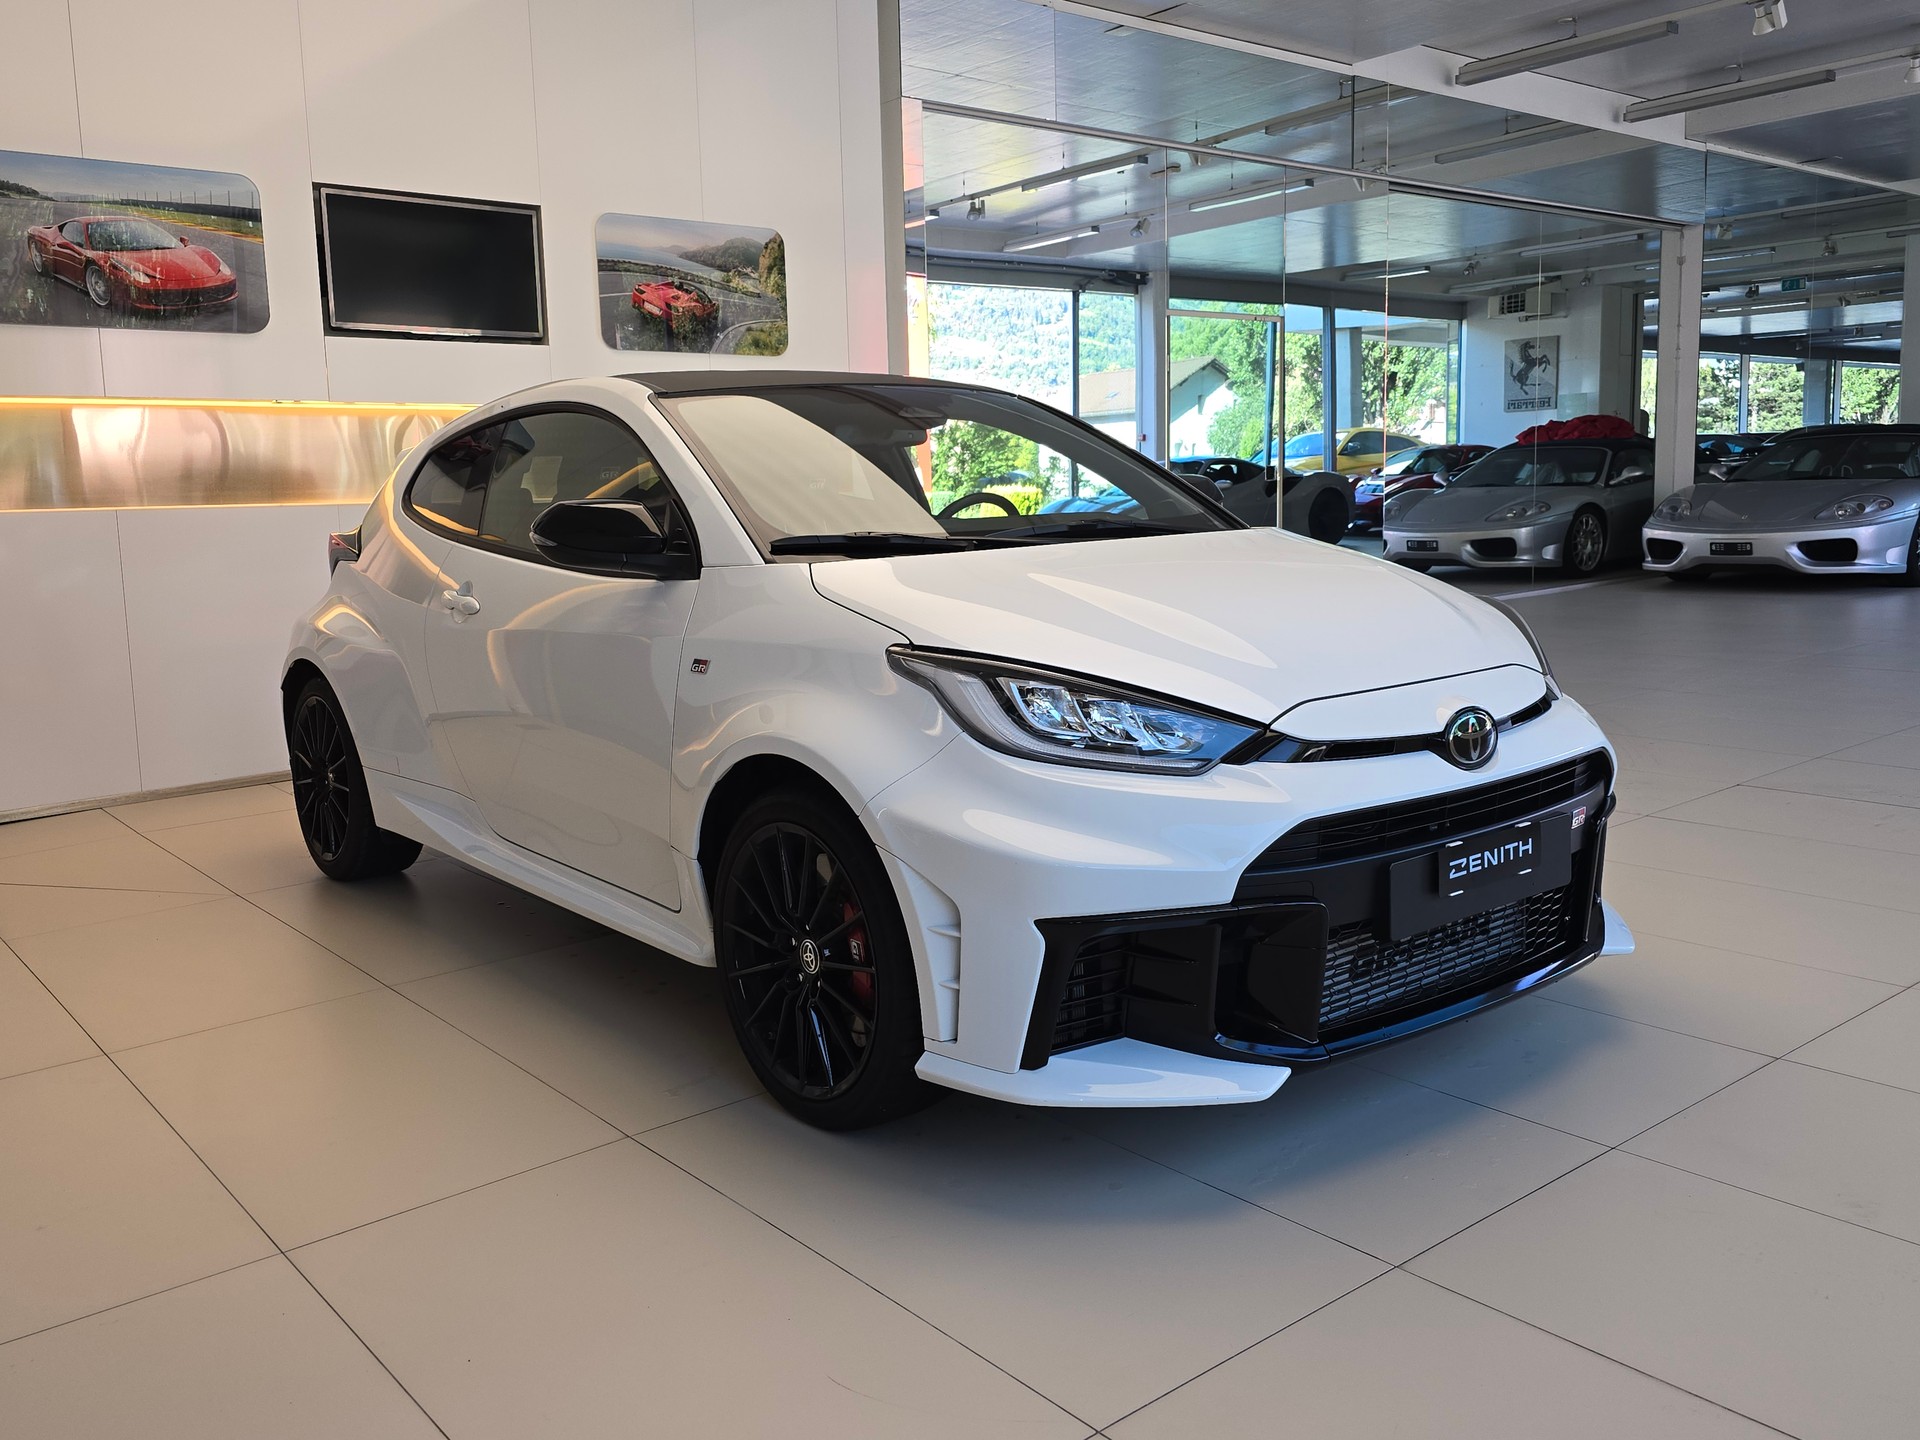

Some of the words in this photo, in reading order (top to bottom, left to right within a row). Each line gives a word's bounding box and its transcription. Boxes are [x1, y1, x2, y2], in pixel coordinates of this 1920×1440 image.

[691, 664, 706, 673] GR
[1572, 815, 1586, 826] GR
[1449, 838, 1533, 880] ZENITH
